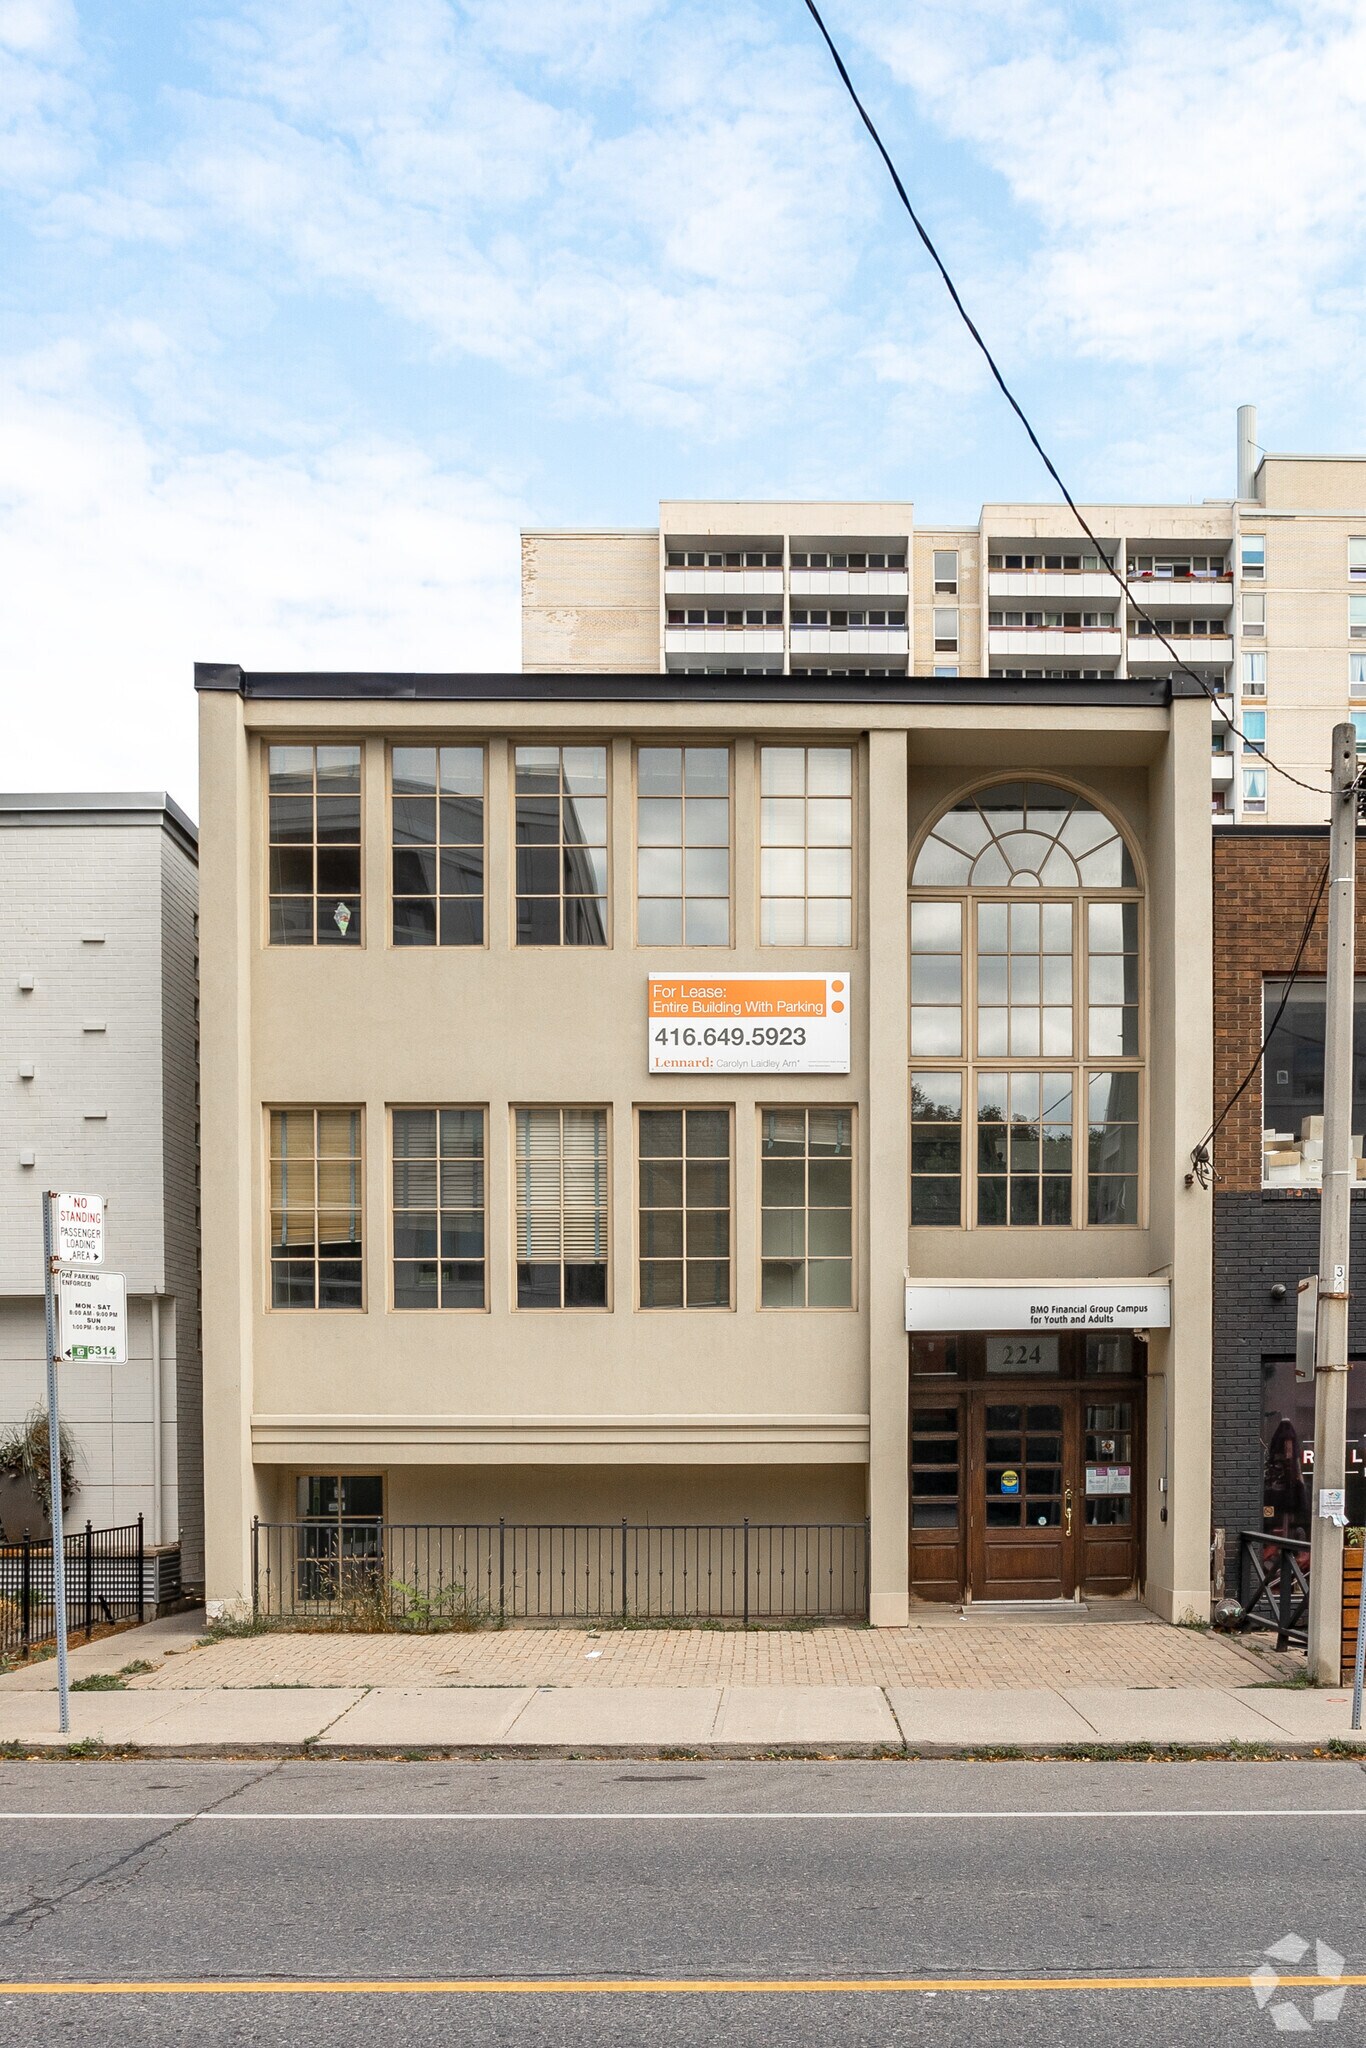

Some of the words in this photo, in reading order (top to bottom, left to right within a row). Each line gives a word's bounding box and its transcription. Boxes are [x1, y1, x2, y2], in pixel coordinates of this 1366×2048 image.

[653, 984, 676, 998] For
[681, 984, 726, 998] Lease:
[653, 1002, 688, 1012] Entire
[692, 1002, 741, 1015] Building
[745, 1001, 773, 1012] With
[777, 1001, 824, 1014] Parking
[654, 1028, 806, 1046] 416.649.5923
[655, 1057, 714, 1068] Lennard:
[716, 1058, 748, 1069] Carolyn
[751, 1058, 780, 1069] Laidley
[74, 1198, 88, 1208] NO
[60, 1210, 101, 1224] STANDING
[60, 1227, 100, 1238] PASSENGER
[66, 1239, 96, 1250] LOADING
[72, 1251, 90, 1260] AREA
[1336, 1266, 1343, 1277] 3
[1030, 1306, 1049, 1314] BMO
[1052, 1304, 1087, 1314] Financial
[1090, 1304, 1114, 1314] Group
[1116, 1304, 1148, 1314] Campus
[1030, 1315, 1042, 1324] for
[1044, 1315, 1068, 1324] Youth
[1070, 1314, 1086, 1323] and
[1088, 1314, 1114, 1323] Adults
[88, 1346, 116, 1355] 6314
[1002, 1344, 1041, 1364] 224
